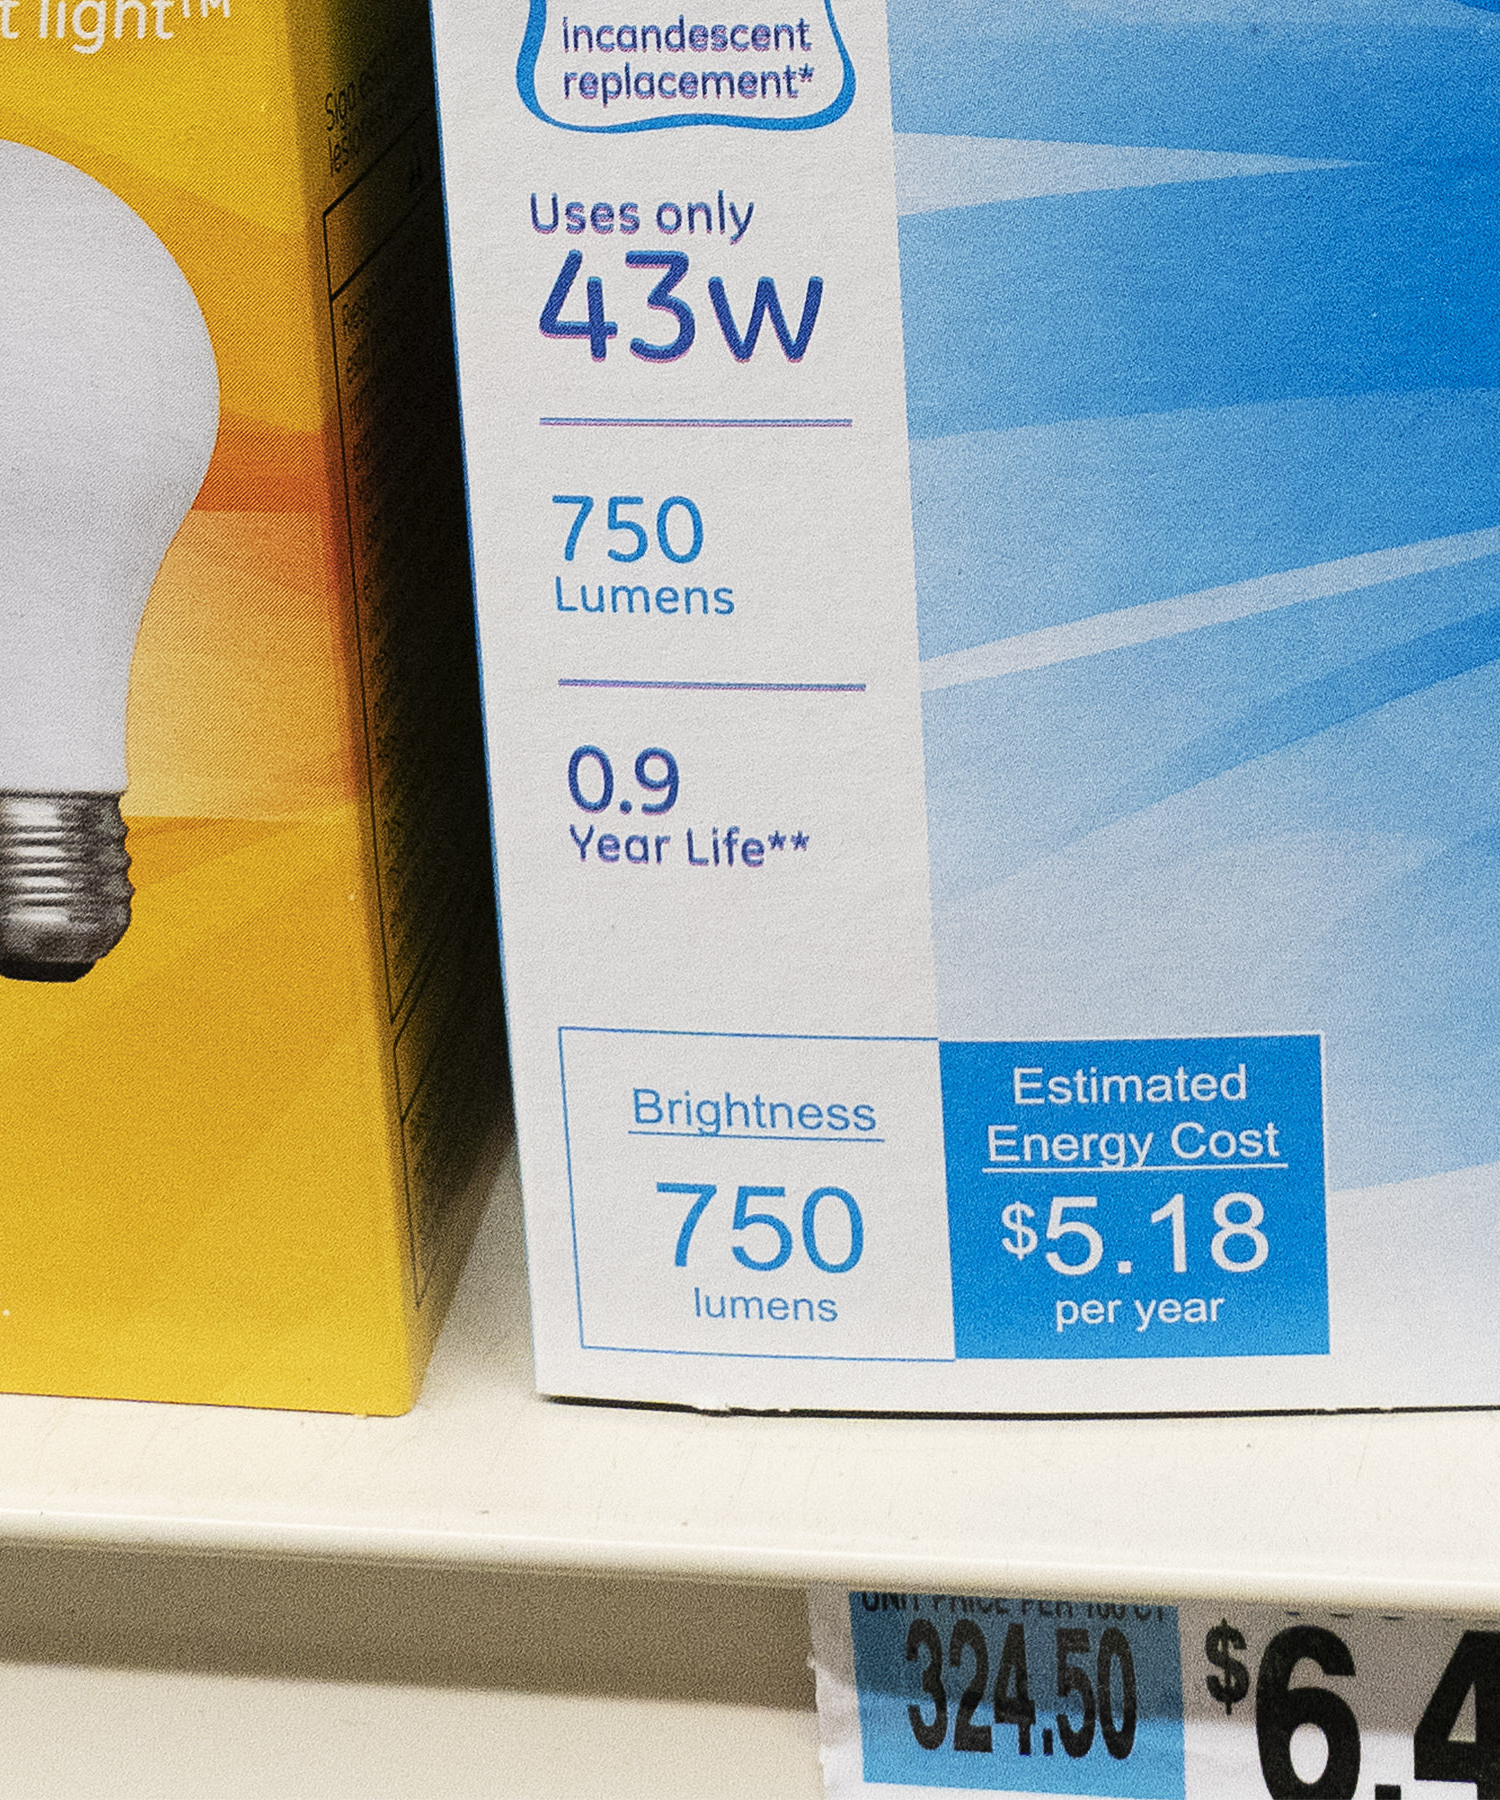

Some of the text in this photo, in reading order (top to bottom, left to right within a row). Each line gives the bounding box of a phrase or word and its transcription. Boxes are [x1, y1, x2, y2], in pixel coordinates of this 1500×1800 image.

[562, 16, 811, 54] incandescent
[531, 191, 755, 245] Uses only
[539, 248, 823, 363] 43w
[552, 495, 704, 564] 750
[555, 576, 735, 615] Lumens
[567, 745, 680, 816] 0.9
[570, 826, 669, 864] Year
[1013, 1064, 1245, 1105] Estimated
[634, 1088, 877, 1136] Brightness
[989, 1120, 1280, 1166] Energy Cost
[656, 1181, 864, 1274] 750
[1001, 1192, 1268, 1277] $5.18
[693, 1287, 838, 1323] lumens
[1056, 1294, 1224, 1332] per year
[904, 1619, 1138, 1760] 324.50
